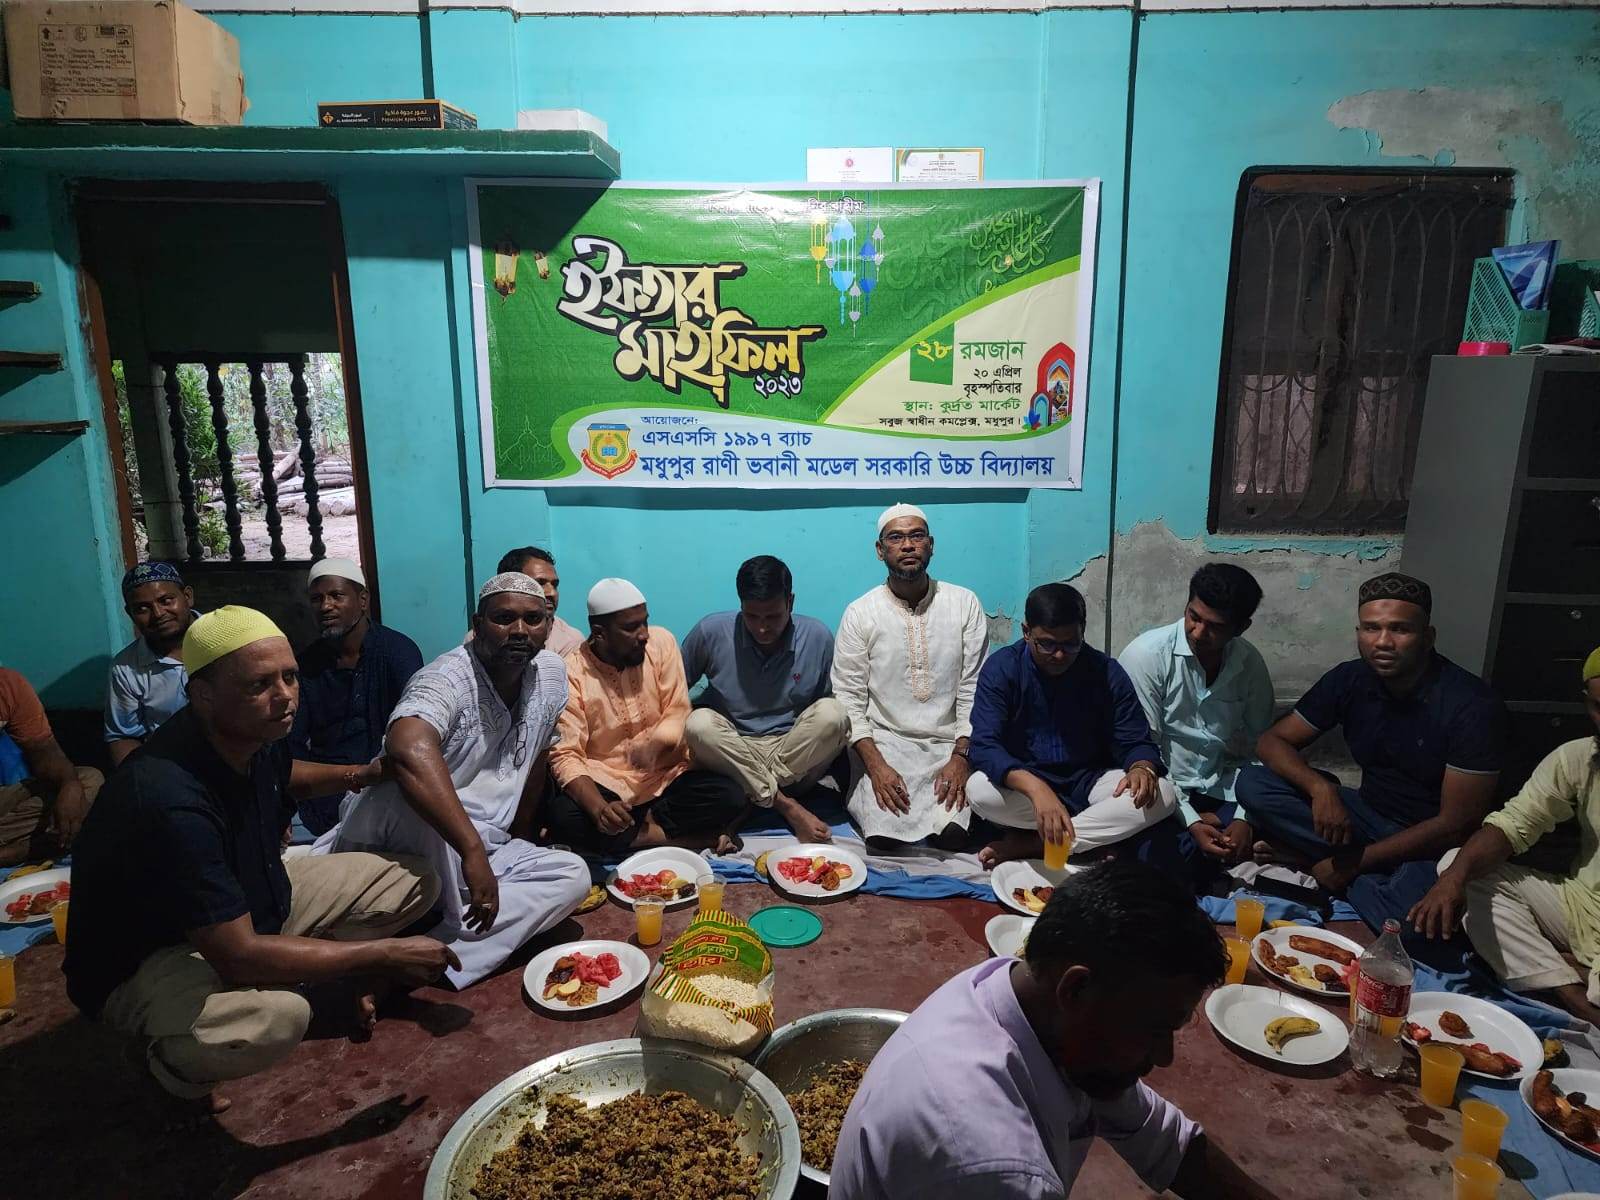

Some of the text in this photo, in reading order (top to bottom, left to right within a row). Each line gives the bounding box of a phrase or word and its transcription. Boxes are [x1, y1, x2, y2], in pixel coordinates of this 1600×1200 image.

[557, 235, 747, 334] ইফতার
[614, 309, 825, 406] মাহফিল
[916, 339, 1027, 362] ২৮ রমজান
[973, 364, 1022, 379] ২০ এপ্রিল
[754, 375, 803, 399] ২০২৩
[963, 380, 1022, 399] বৃহস্পতিবার
[979, 398, 1022, 411] মার্কেট
[879, 416, 903, 427] সবুজ
[907, 415, 935, 426] স্বাধীন
[642, 426, 814, 447] এসএসসি ১৯৯৭ ব্যাচ
[639, 456, 696, 480] মধুপুর
[702, 450, 740, 476] রাণী
[745, 450, 800, 476] ভবানী
[805, 456, 859, 476] মডেল
[864, 451, 933, 477] সরকারি
[937, 450, 975, 476] উচ্চ
[979, 451, 1055, 477] বিদ্যালয়
